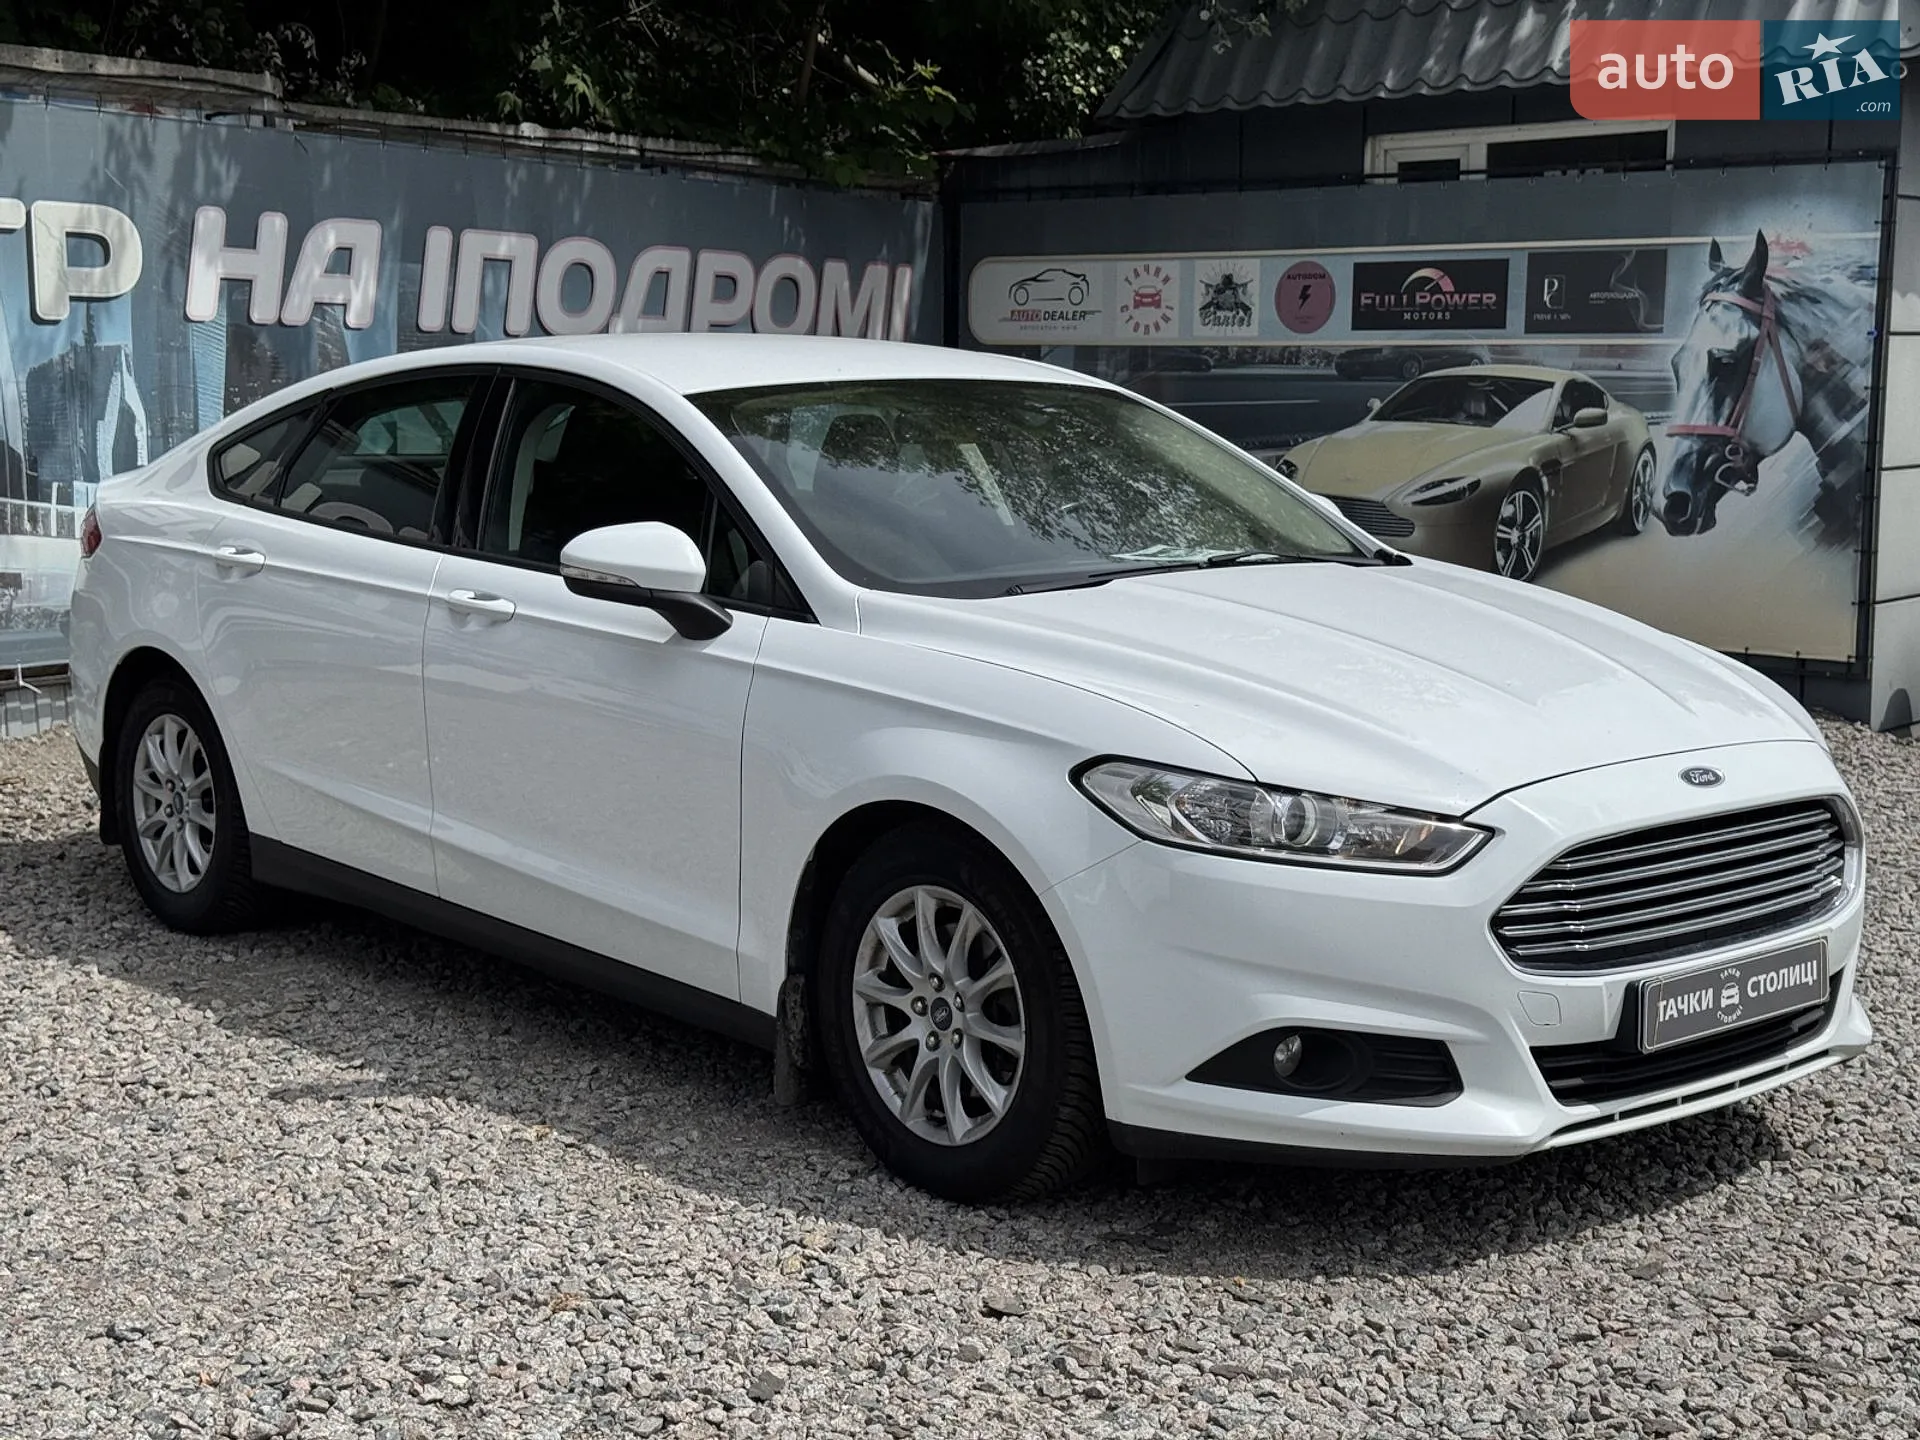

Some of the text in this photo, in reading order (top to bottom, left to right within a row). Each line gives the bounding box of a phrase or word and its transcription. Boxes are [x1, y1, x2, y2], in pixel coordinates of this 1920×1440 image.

[184, 206, 382, 329] НА
[417, 226, 911, 341] ІПОДРОМІ
[1011, 310, 1087, 321] AUTO DEALER
[1403, 312, 1451, 320] MOTORS
[1689, 769, 1716, 783] Ford
[1747, 960, 1818, 998] СТОЛИЦІ
[1658, 987, 1714, 1022] ТАЧКИ
